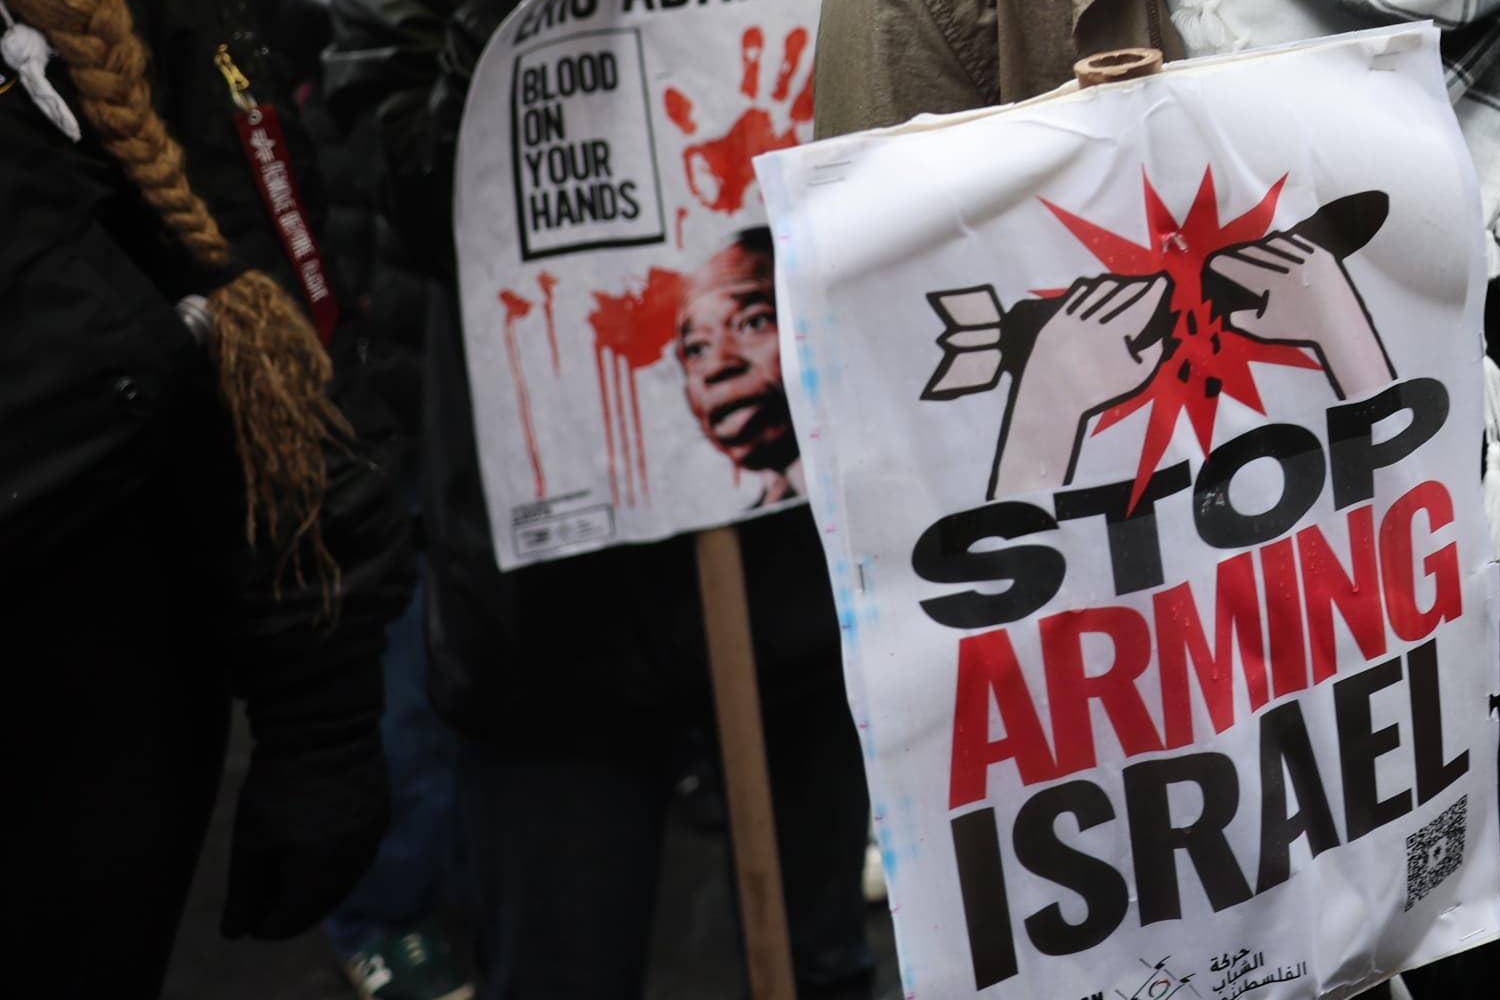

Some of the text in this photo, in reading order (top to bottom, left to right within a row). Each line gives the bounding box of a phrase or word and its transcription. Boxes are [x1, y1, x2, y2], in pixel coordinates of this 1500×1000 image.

[522, 51, 619, 105] BLOOD
[523, 103, 565, 146] ON
[524, 139, 612, 188] YOUR
[530, 181, 640, 233] HANDS
[911, 376, 1450, 630] STOP
[948, 480, 1464, 811] ARMING
[950, 637, 1471, 992] ISRAEL
[1209, 948, 1250, 972] حركة
[1212, 951, 1264, 994] الشباب
[1221, 960, 1307, 1000] الفلسطين
